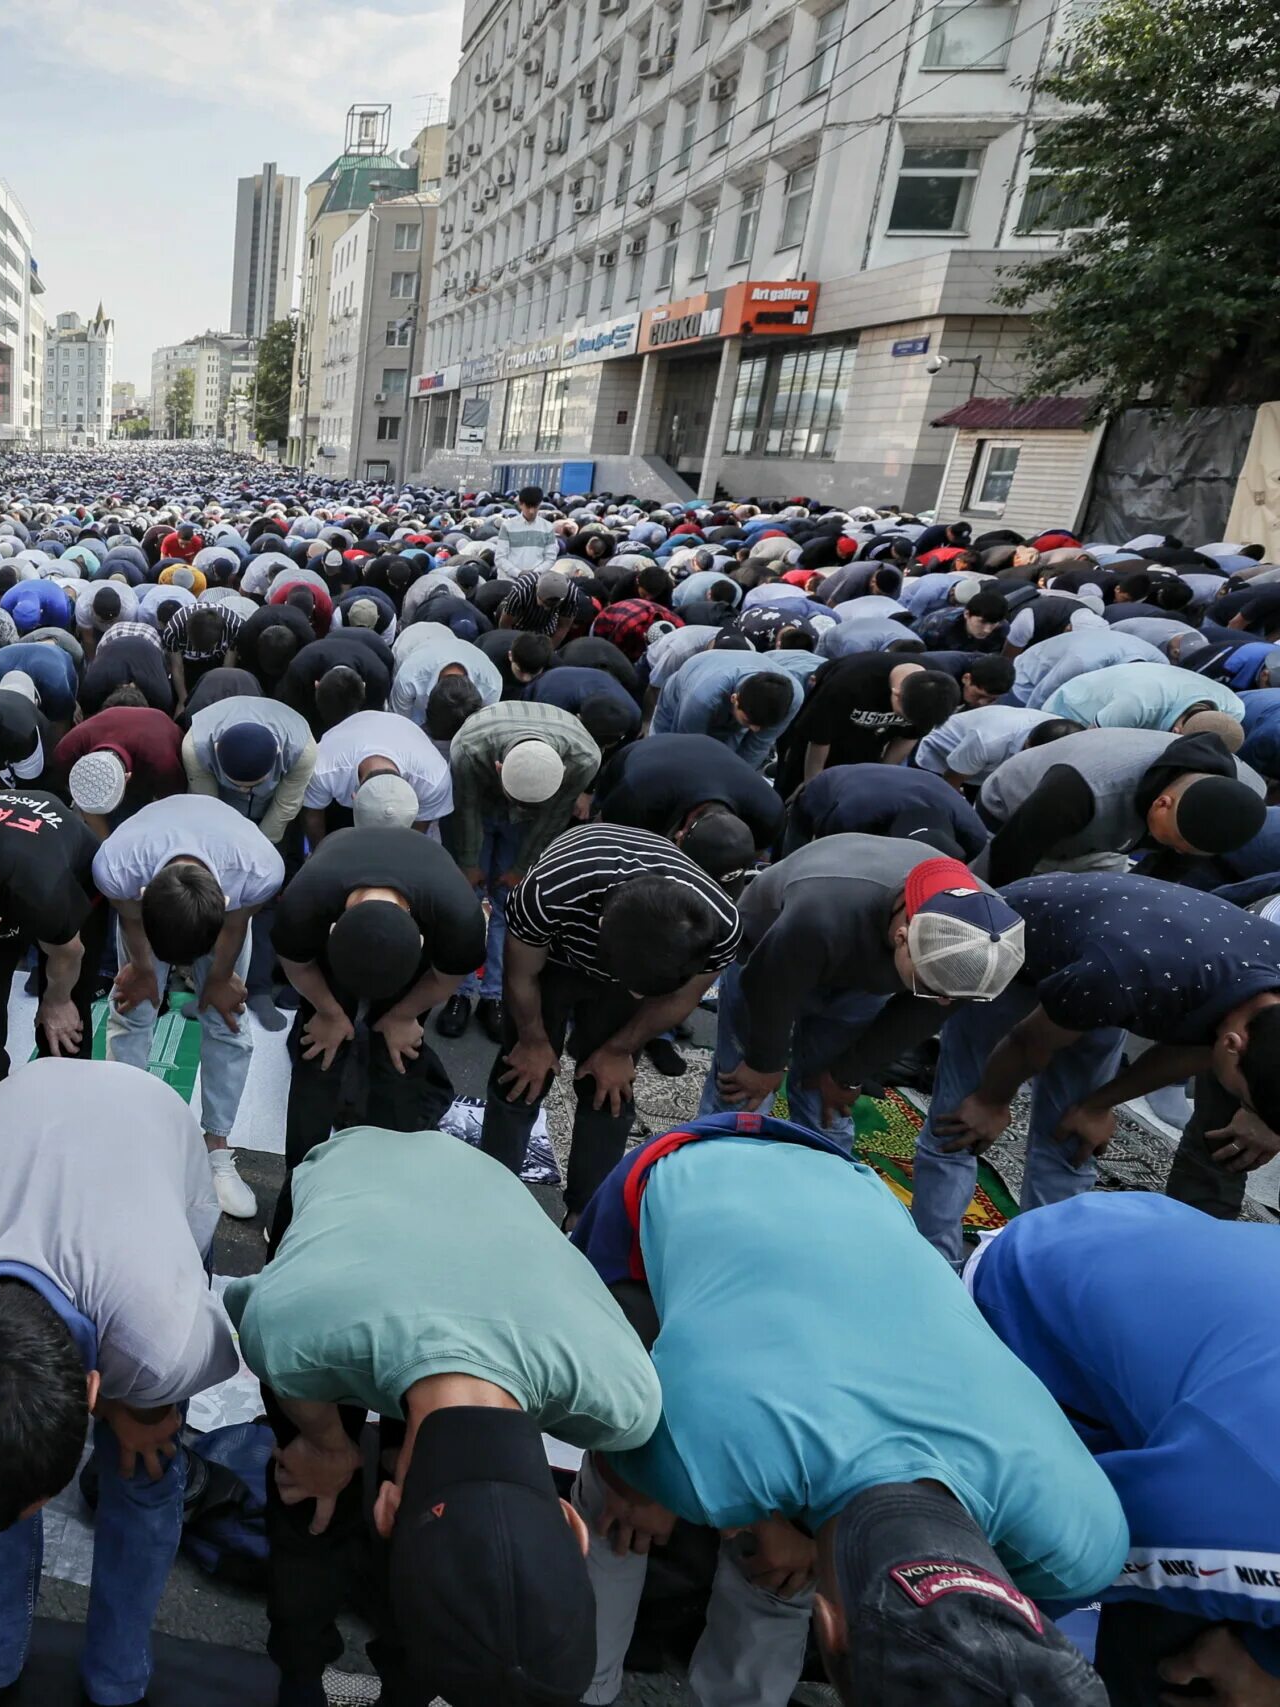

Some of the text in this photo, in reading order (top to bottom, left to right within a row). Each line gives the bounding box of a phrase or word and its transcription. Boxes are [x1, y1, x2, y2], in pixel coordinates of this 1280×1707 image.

[751, 287, 809, 302] Art gallery
[649, 307, 722, 346] СОВКОМ
[899, 1564, 974, 1578] CANADA
[1158, 1559, 1200, 1579] NIKE
[1234, 1565, 1280, 1587] NIKE
